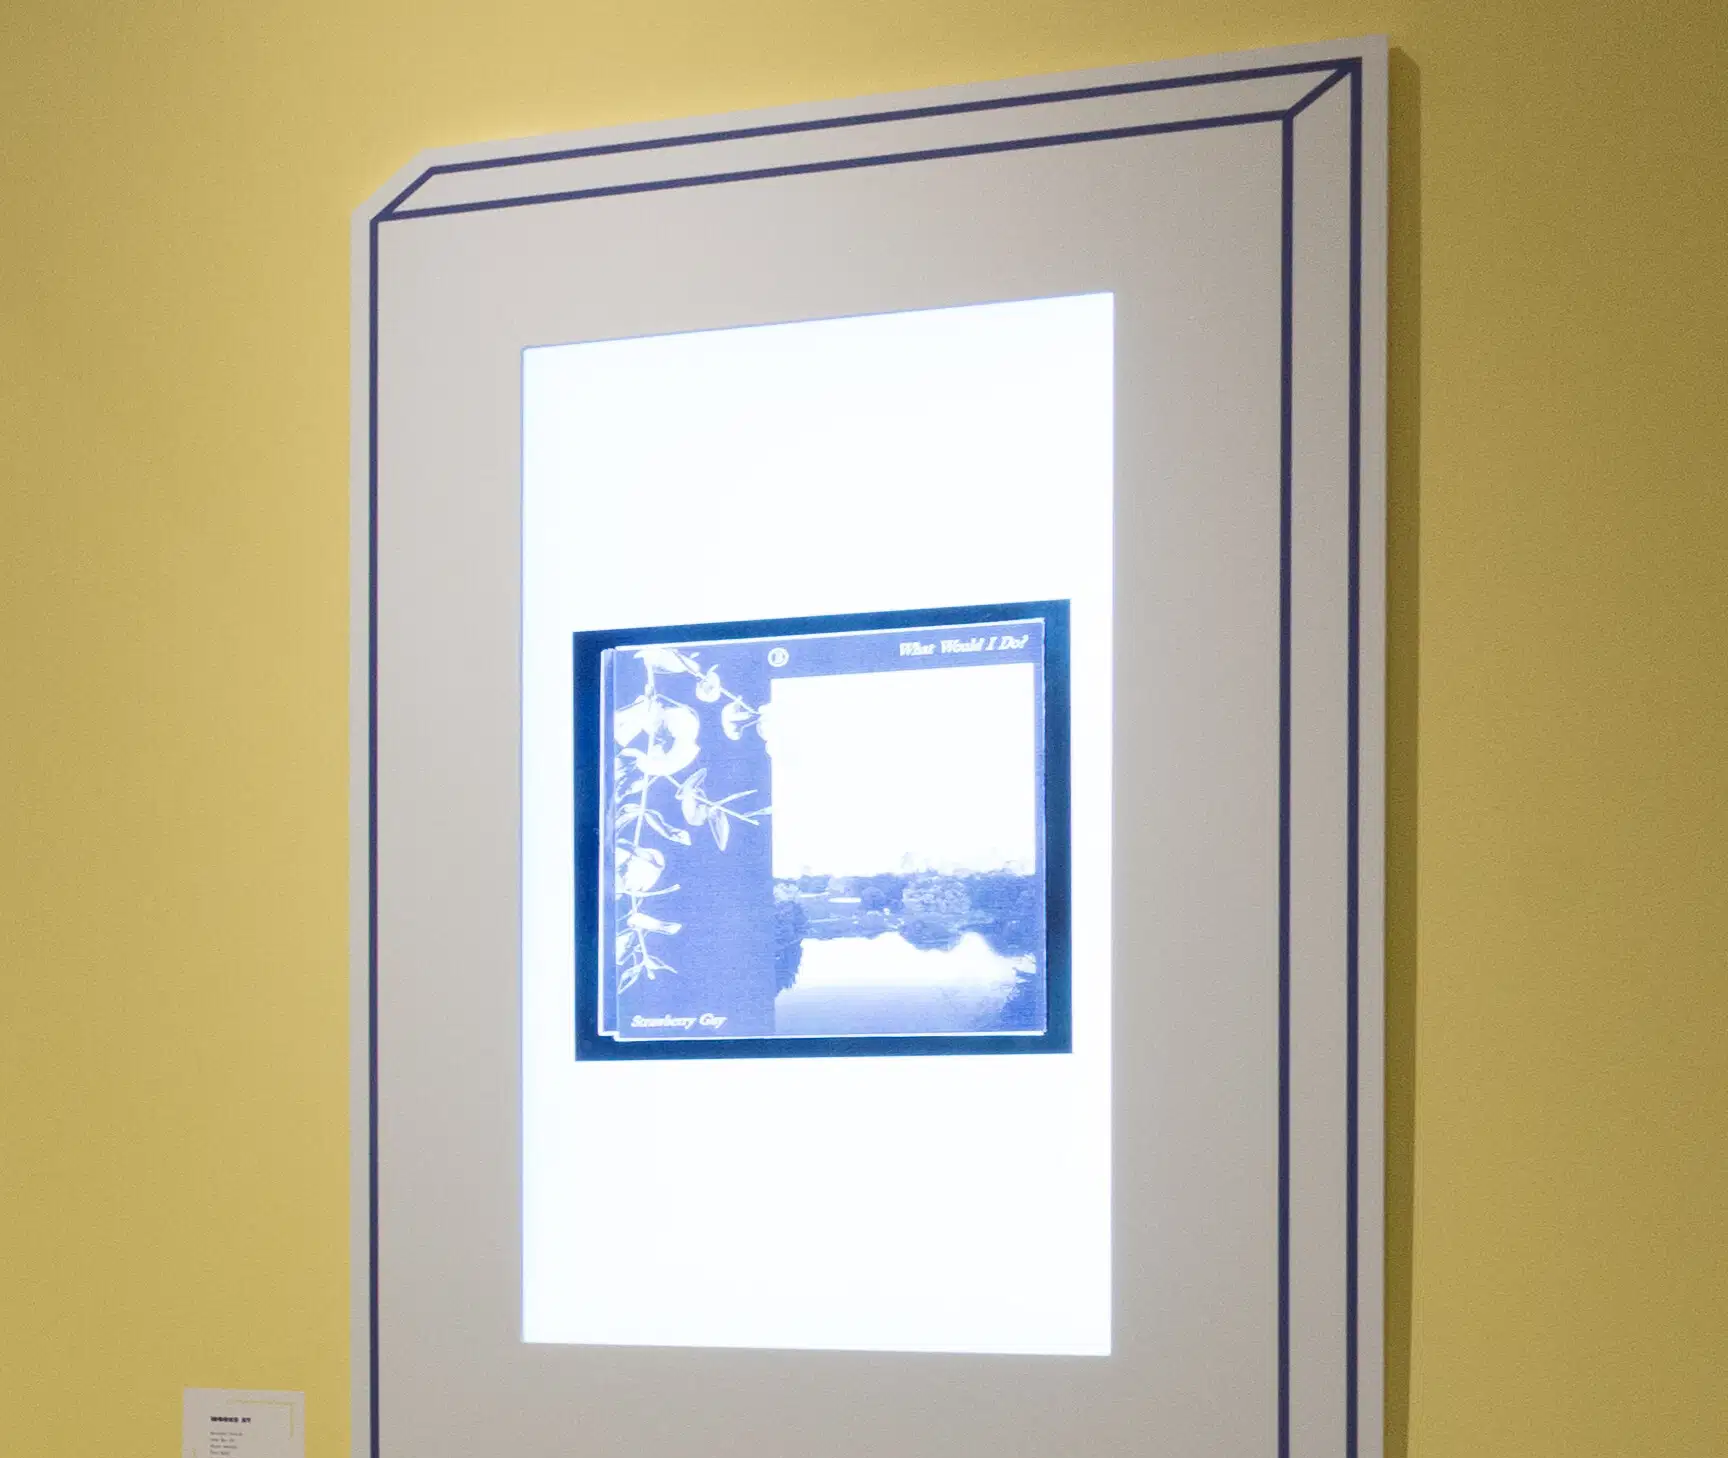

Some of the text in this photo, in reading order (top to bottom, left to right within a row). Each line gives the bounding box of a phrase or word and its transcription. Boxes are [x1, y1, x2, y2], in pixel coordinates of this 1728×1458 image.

[899, 641, 936, 657] What
[940, 637, 985, 654] Would
[985, 636, 998, 651] I
